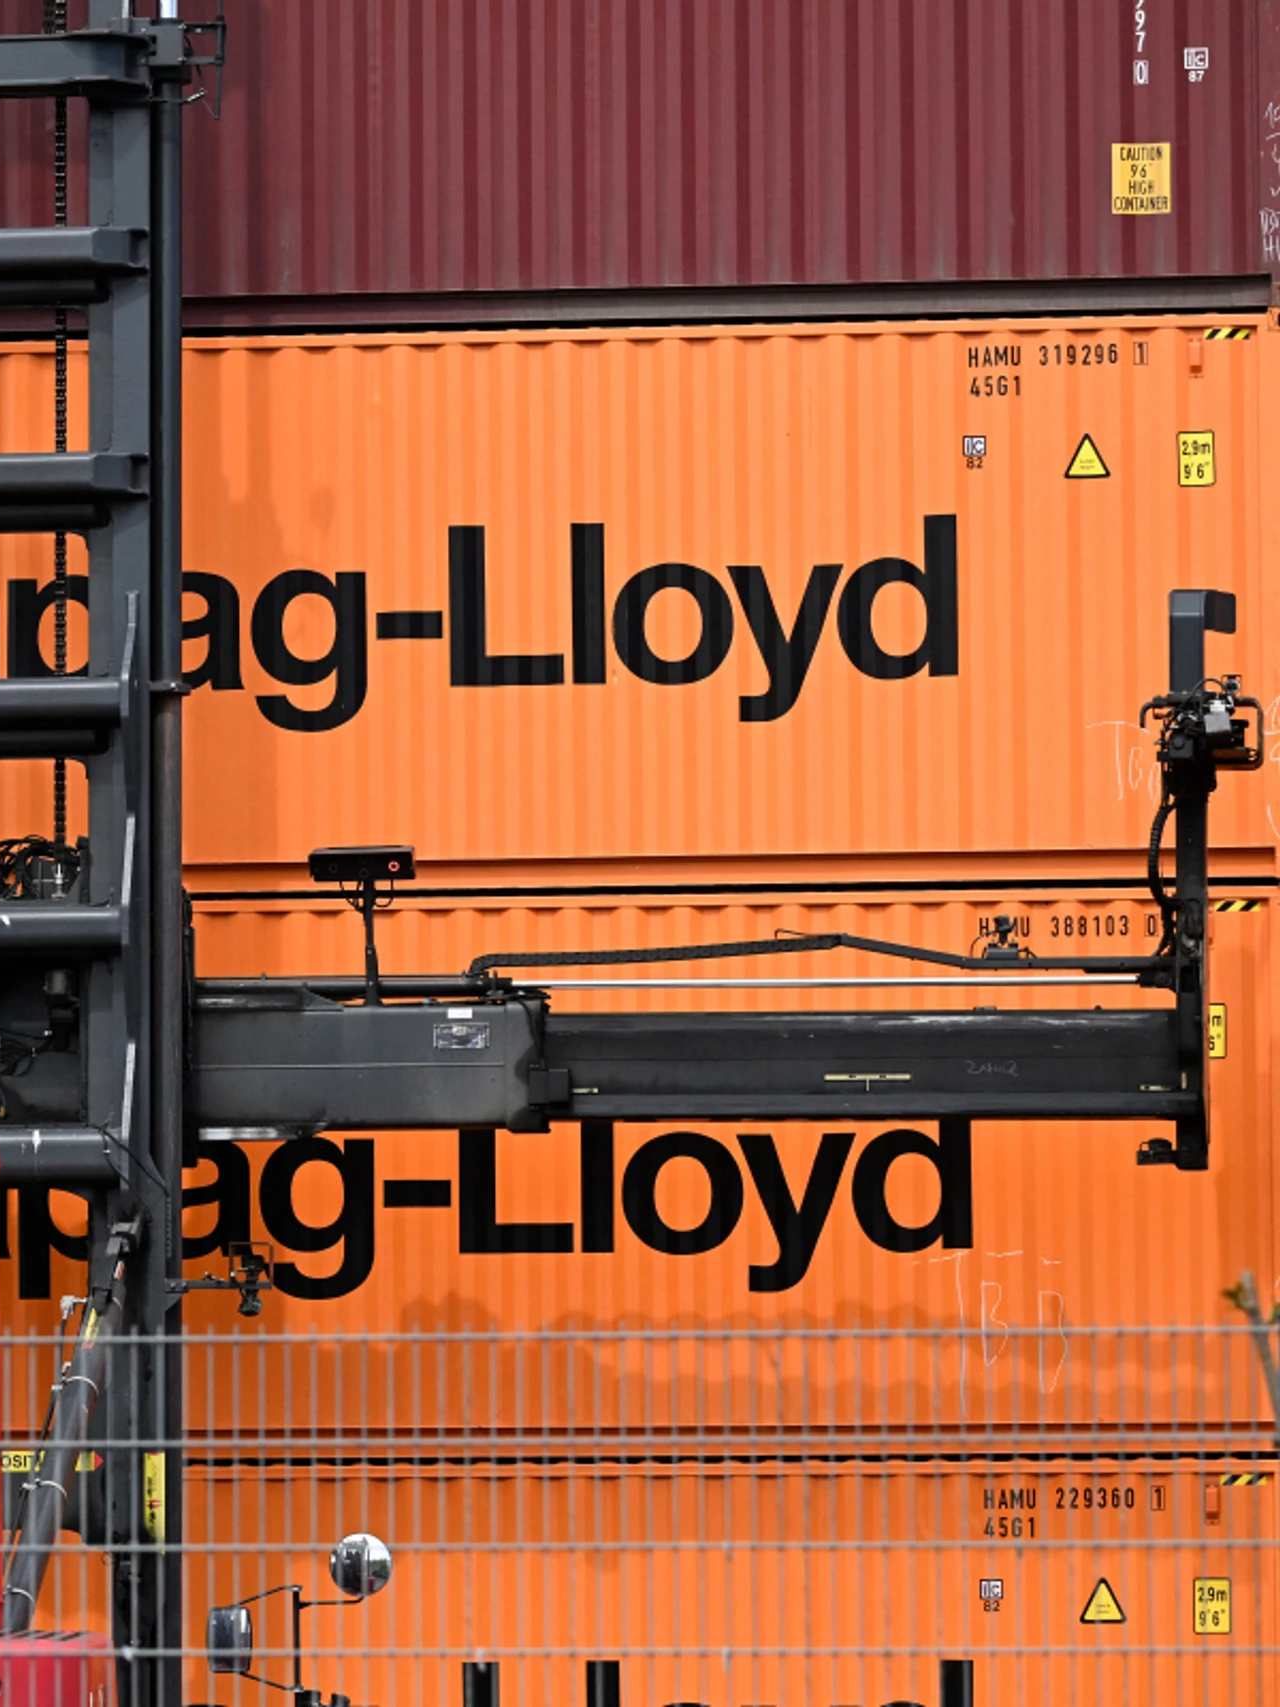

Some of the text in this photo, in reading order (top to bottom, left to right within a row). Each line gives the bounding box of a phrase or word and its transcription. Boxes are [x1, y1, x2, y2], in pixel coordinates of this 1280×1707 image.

[1135, 61, 1148, 84] 0
[1188, 70, 1205, 82] 87
[1120, 146, 1163, 161] CAUTION
[1128, 180, 1155, 195] HIGH
[1114, 196, 1168, 212] CONTAINER
[968, 342, 1148, 369] HAMU 319296 1
[970, 375, 1022, 398] 45G1
[966, 457, 983, 469] 82
[979, 915, 1158, 938] HMU 388103 0
[983, 1486, 1165, 1510] HAMU 229360 1
[984, 1516, 1036, 1538] 45G1
[983, 1600, 1000, 1612] 82
